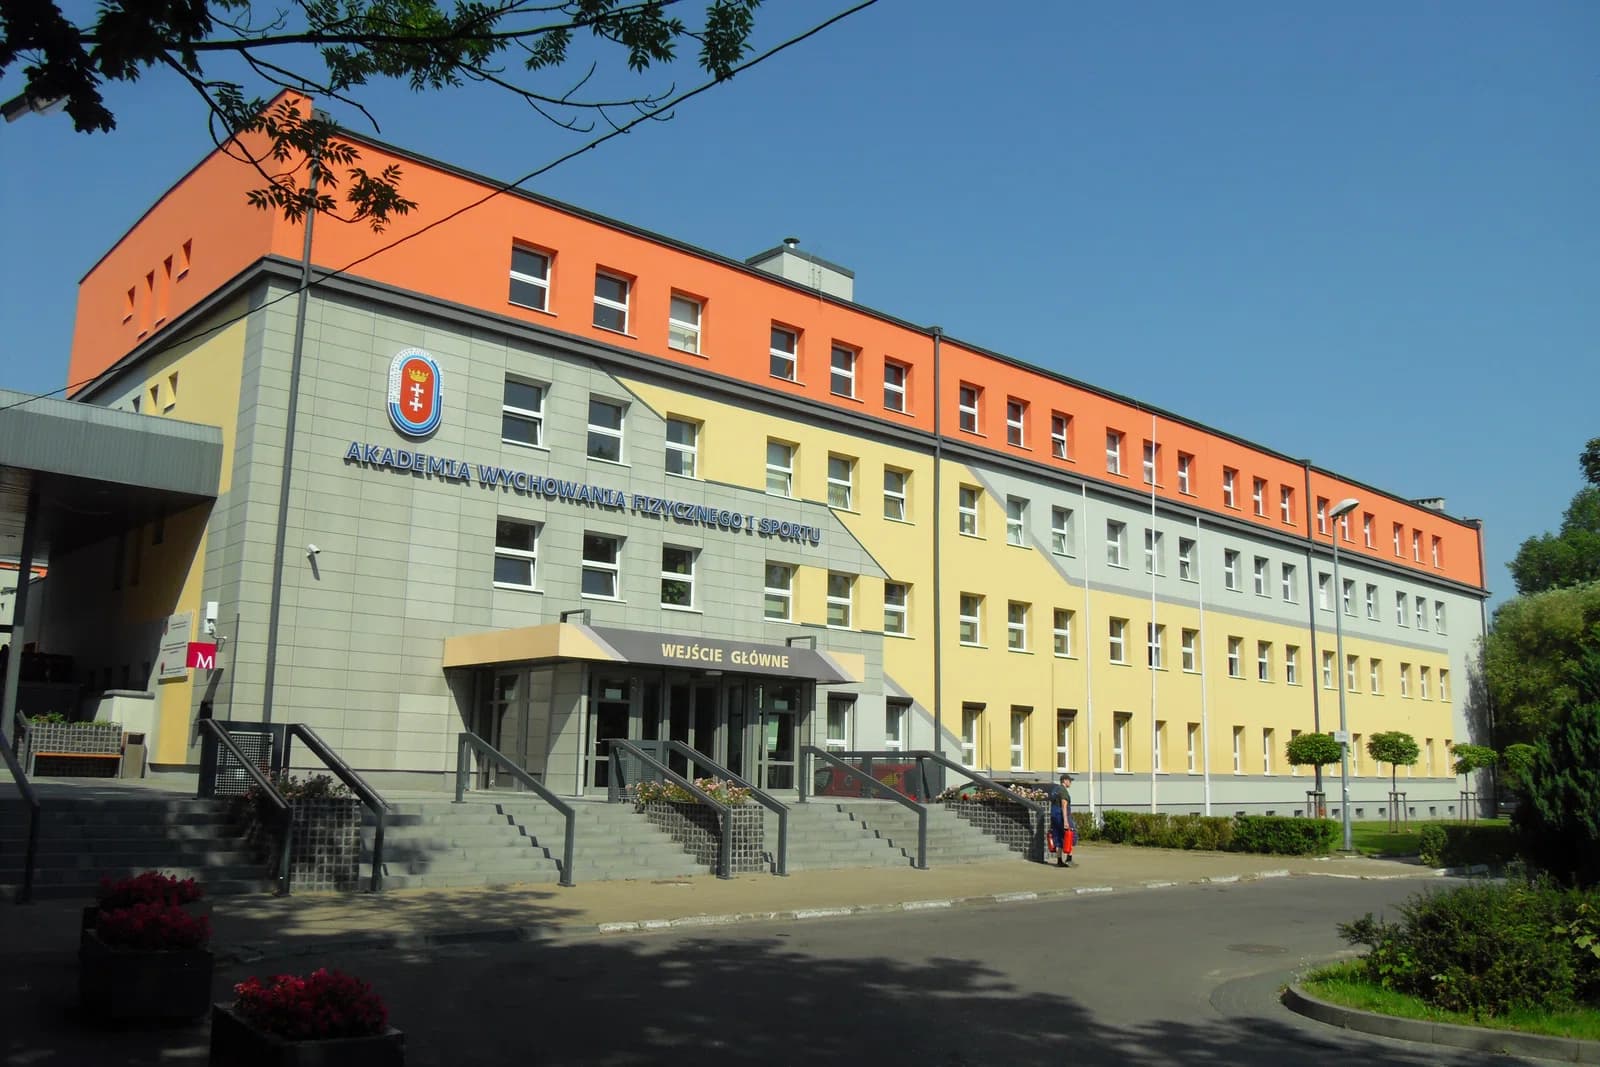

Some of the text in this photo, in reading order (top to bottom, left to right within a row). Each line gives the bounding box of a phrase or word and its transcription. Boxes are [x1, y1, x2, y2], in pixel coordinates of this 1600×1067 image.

[346, 441, 821, 542] AKADEMIA WYCHOWANIA FIZYCZNEGO I SPORTU
[196, 652, 213, 669] M
[661, 643, 789, 668] WEJŚCIE GŁÓWNE
